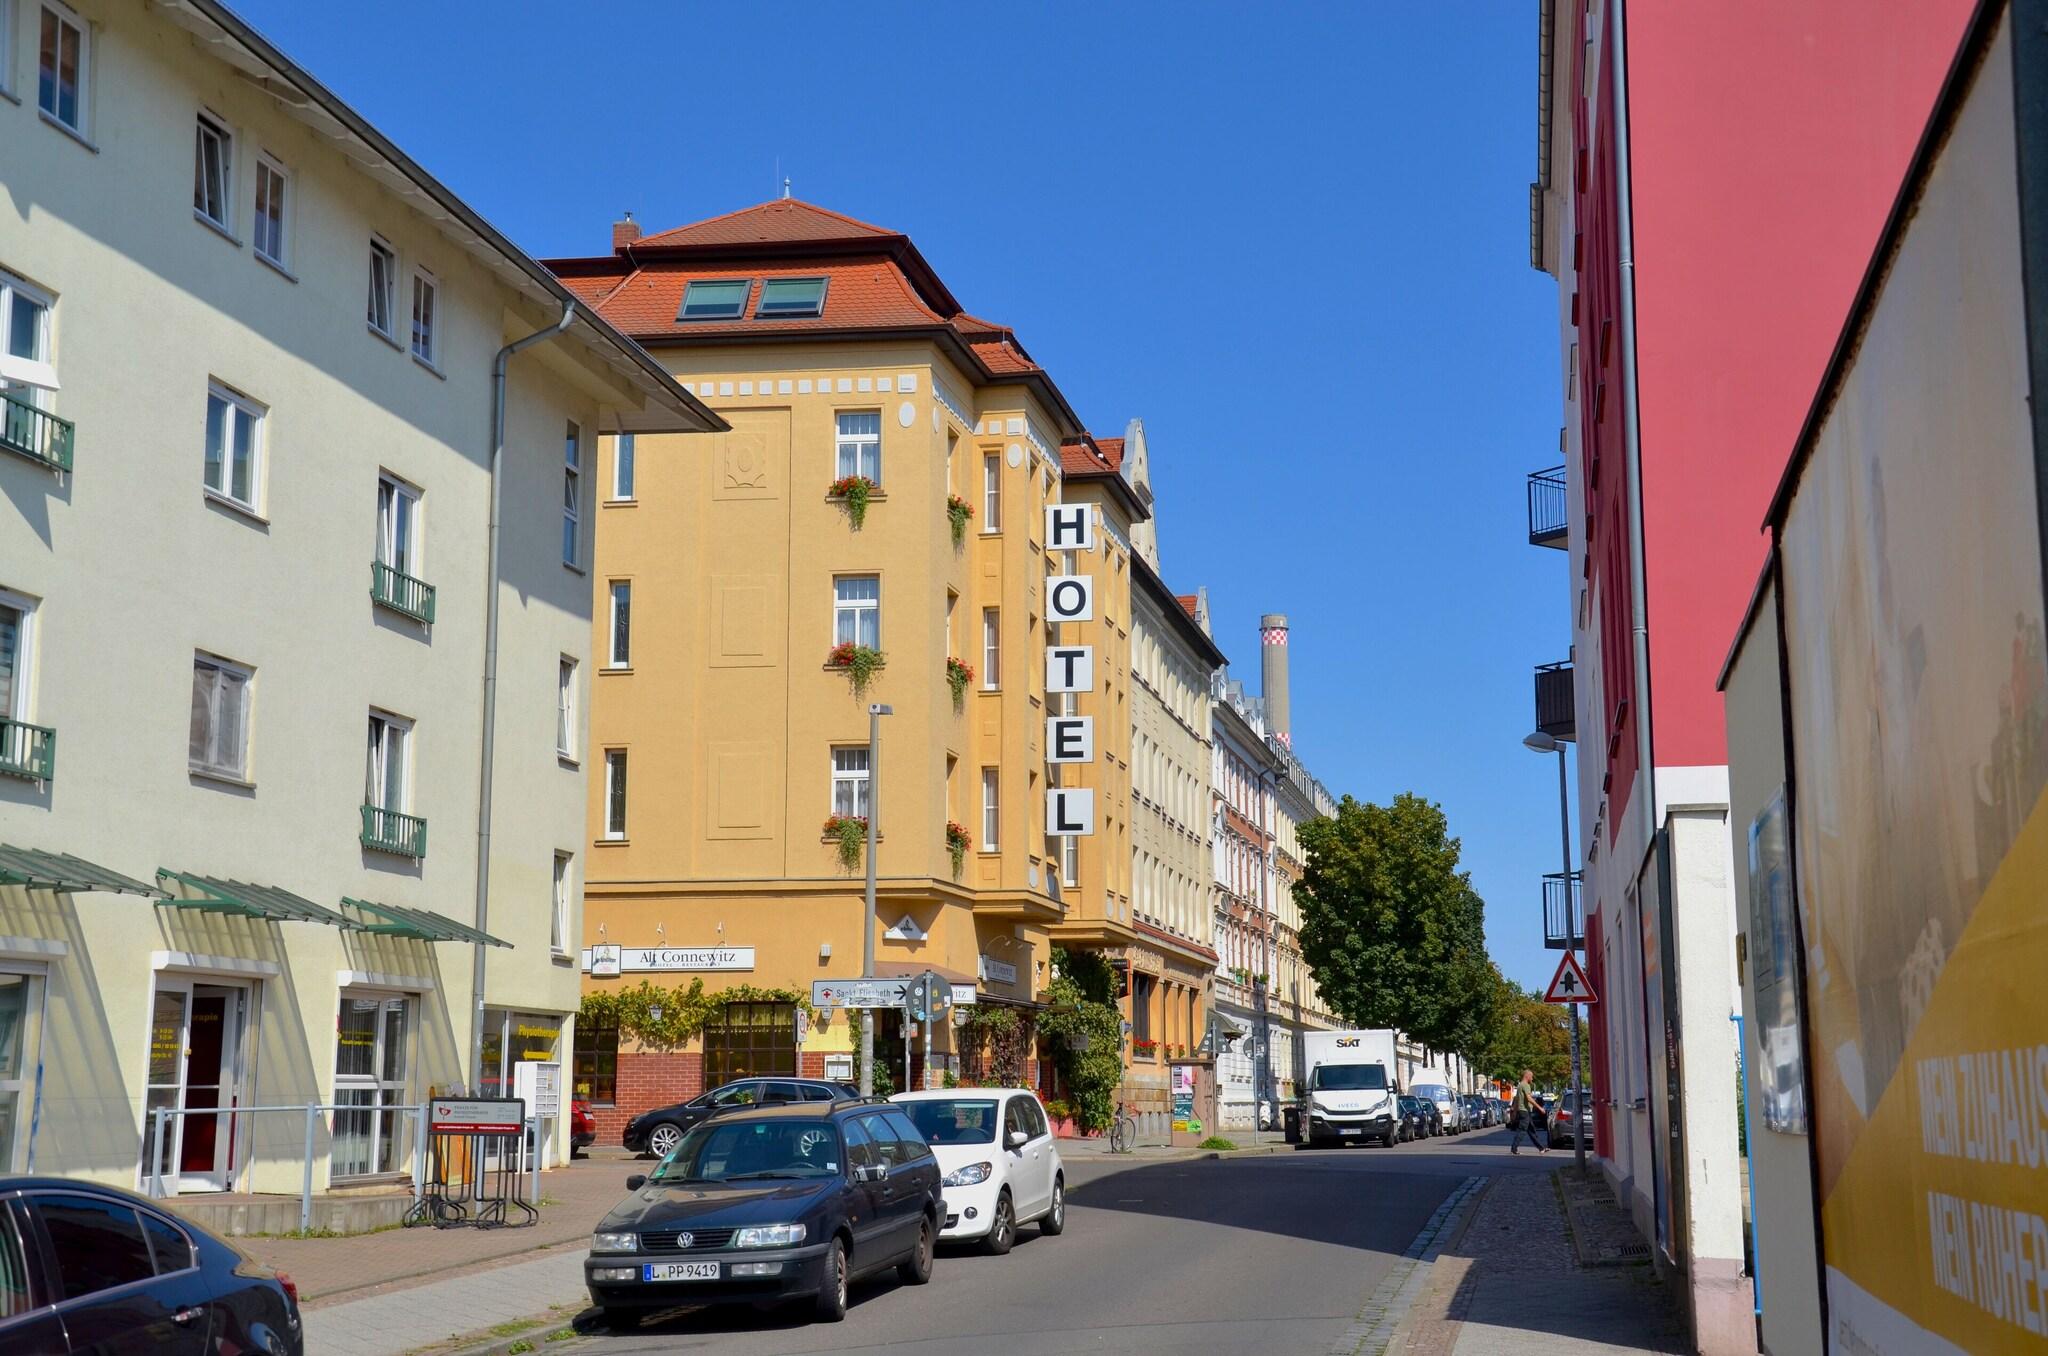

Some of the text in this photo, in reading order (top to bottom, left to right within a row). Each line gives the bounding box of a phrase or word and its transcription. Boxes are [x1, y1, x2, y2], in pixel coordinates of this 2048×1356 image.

[1053, 508, 1087, 832] HOTEL
[640, 950, 736, 963] Alt Connewitz
[836, 988, 856, 998] Sankt
[1336, 1037, 1361, 1048] SIXT
[1917, 1055, 1961, 1158] MEIN
[1928, 1190, 1974, 1304] MEIN
